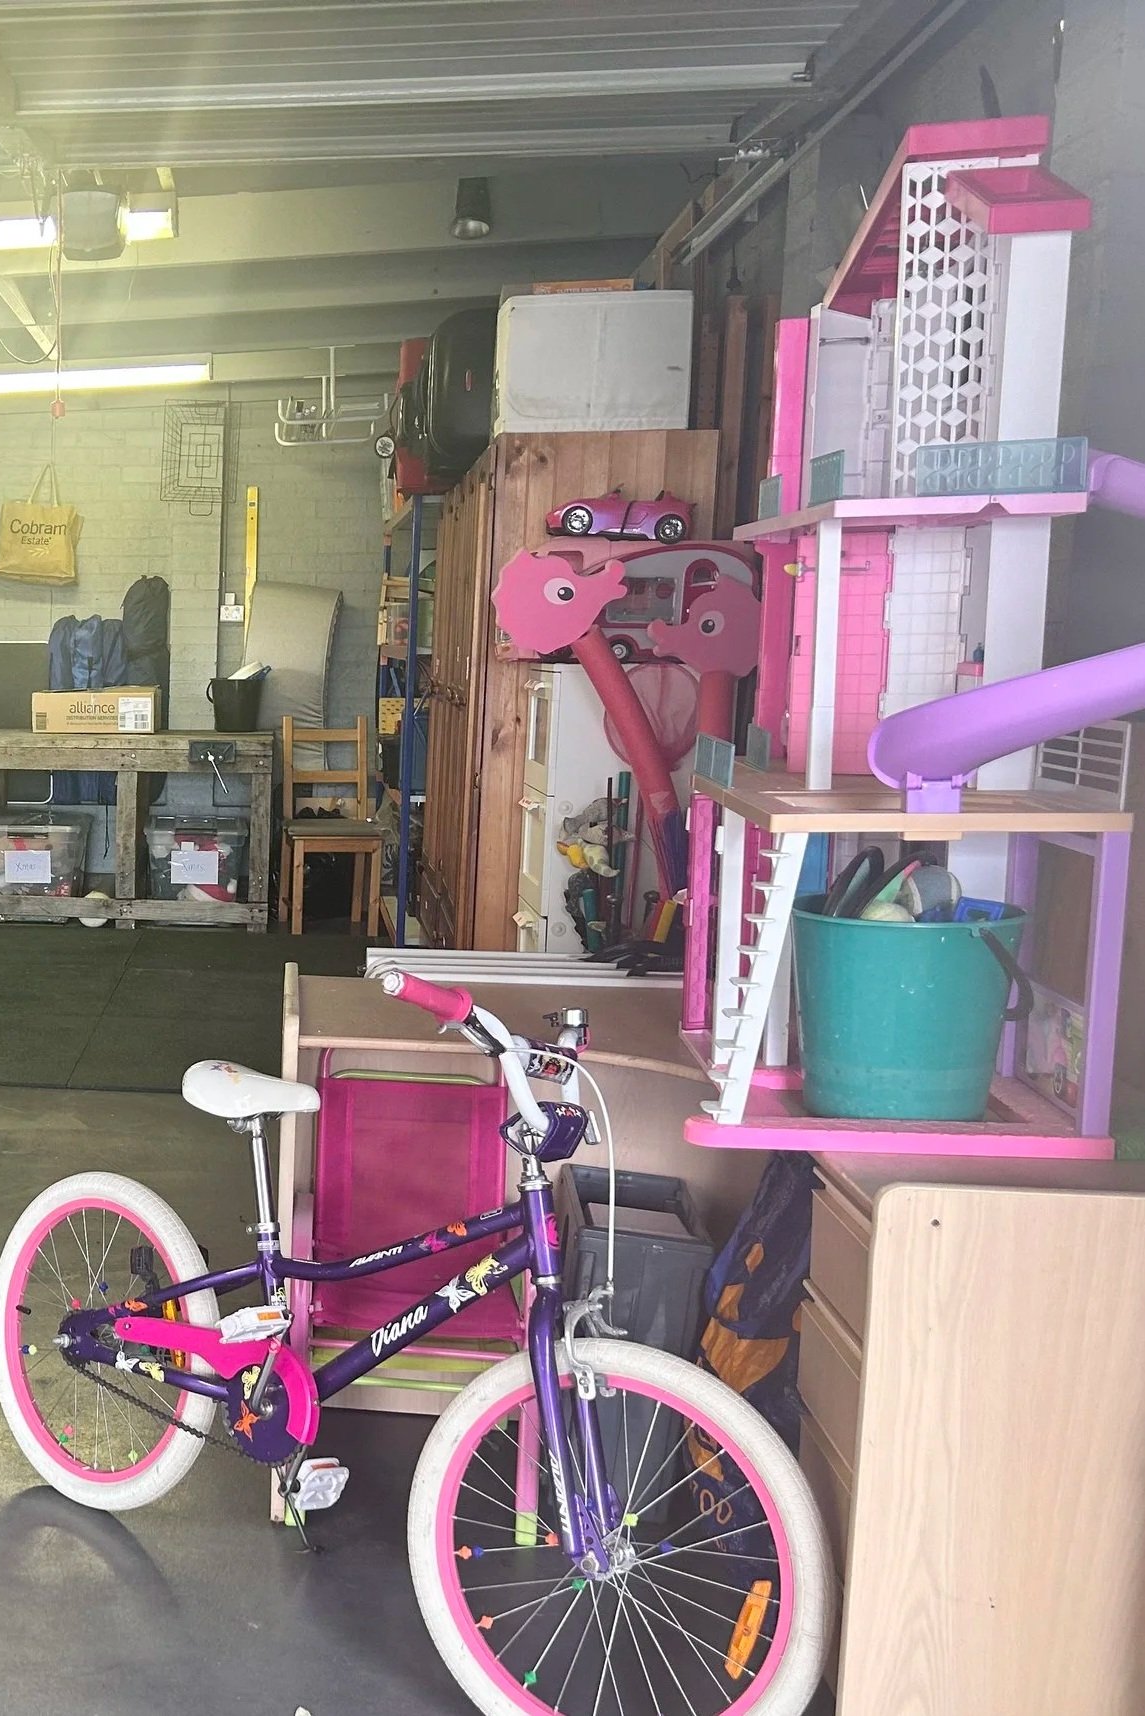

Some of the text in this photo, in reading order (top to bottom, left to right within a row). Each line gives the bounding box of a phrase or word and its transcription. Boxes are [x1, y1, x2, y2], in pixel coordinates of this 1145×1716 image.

[10, 518, 67, 535] Cobram
[21, 535, 50, 546] Estate
[69, 701, 116, 714] alliance
[348, 1244, 404, 1269] AVANTI
[370, 1304, 429, 1357] Diana
